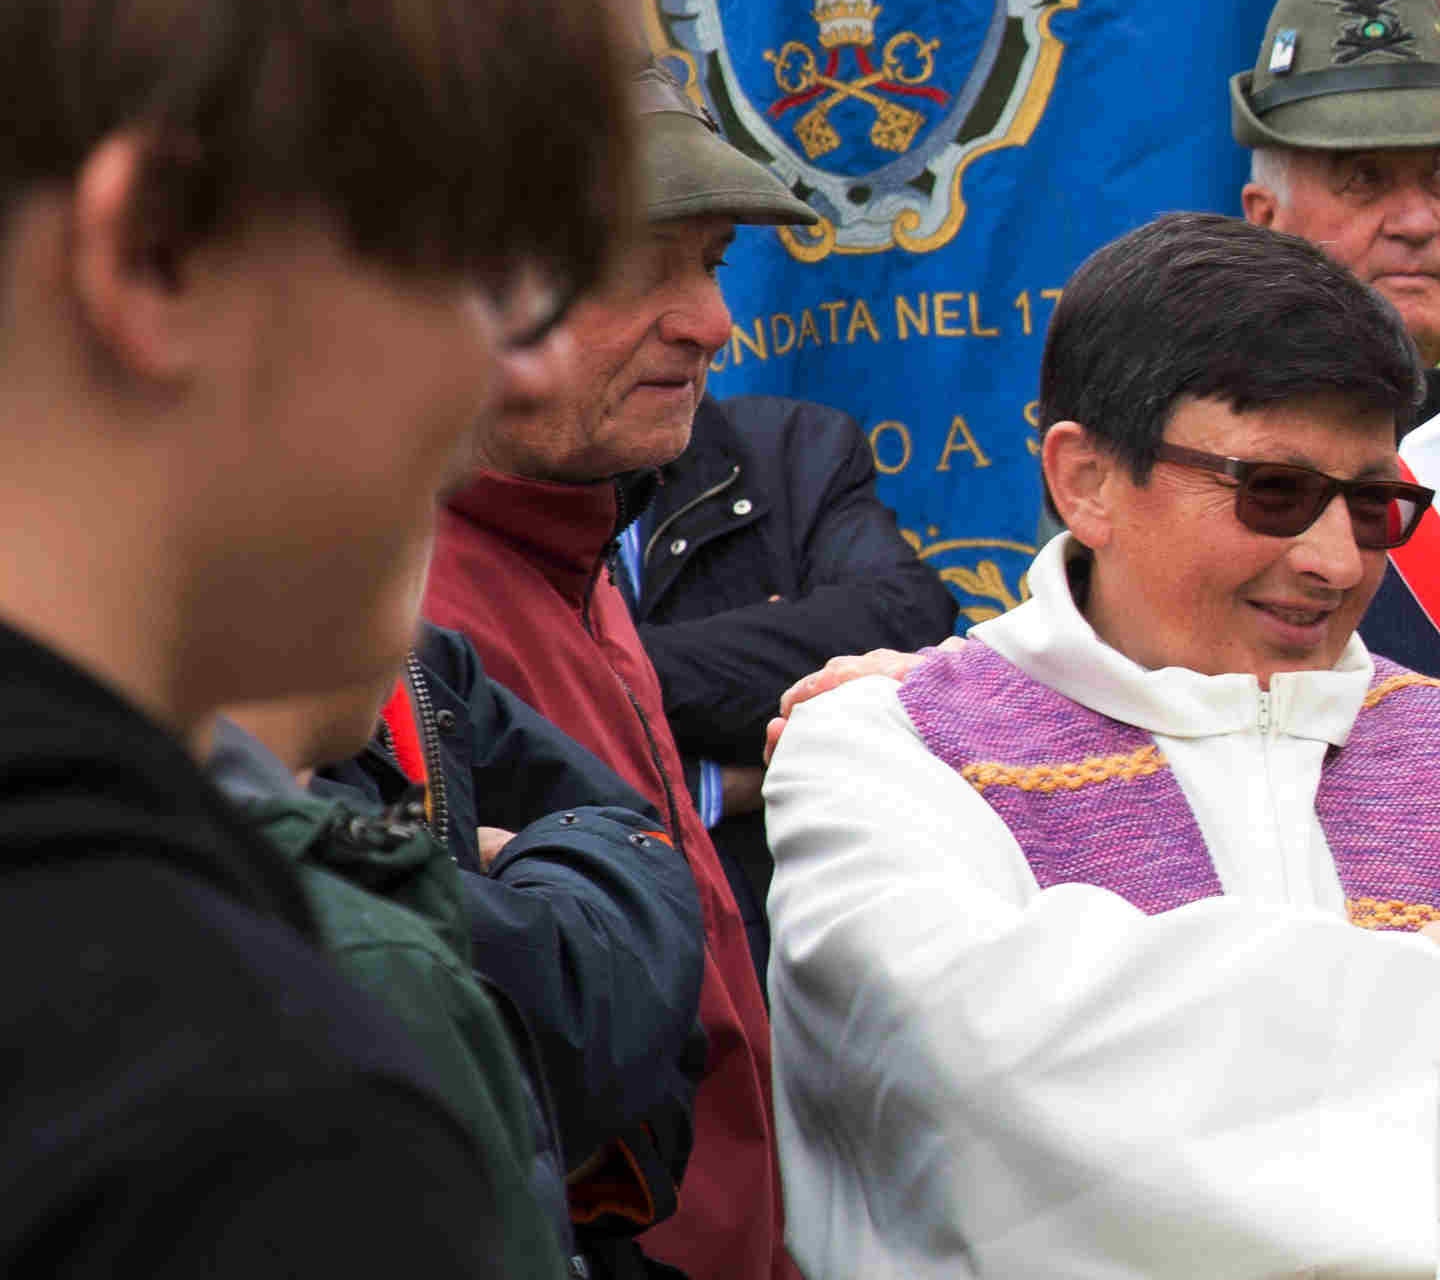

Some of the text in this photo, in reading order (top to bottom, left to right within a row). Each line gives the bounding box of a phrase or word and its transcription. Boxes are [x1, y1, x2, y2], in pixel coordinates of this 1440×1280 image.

[708, 299, 881, 373] NDATA
[894, 290, 1000, 341] NEL
[935, 416, 991, 472] A
